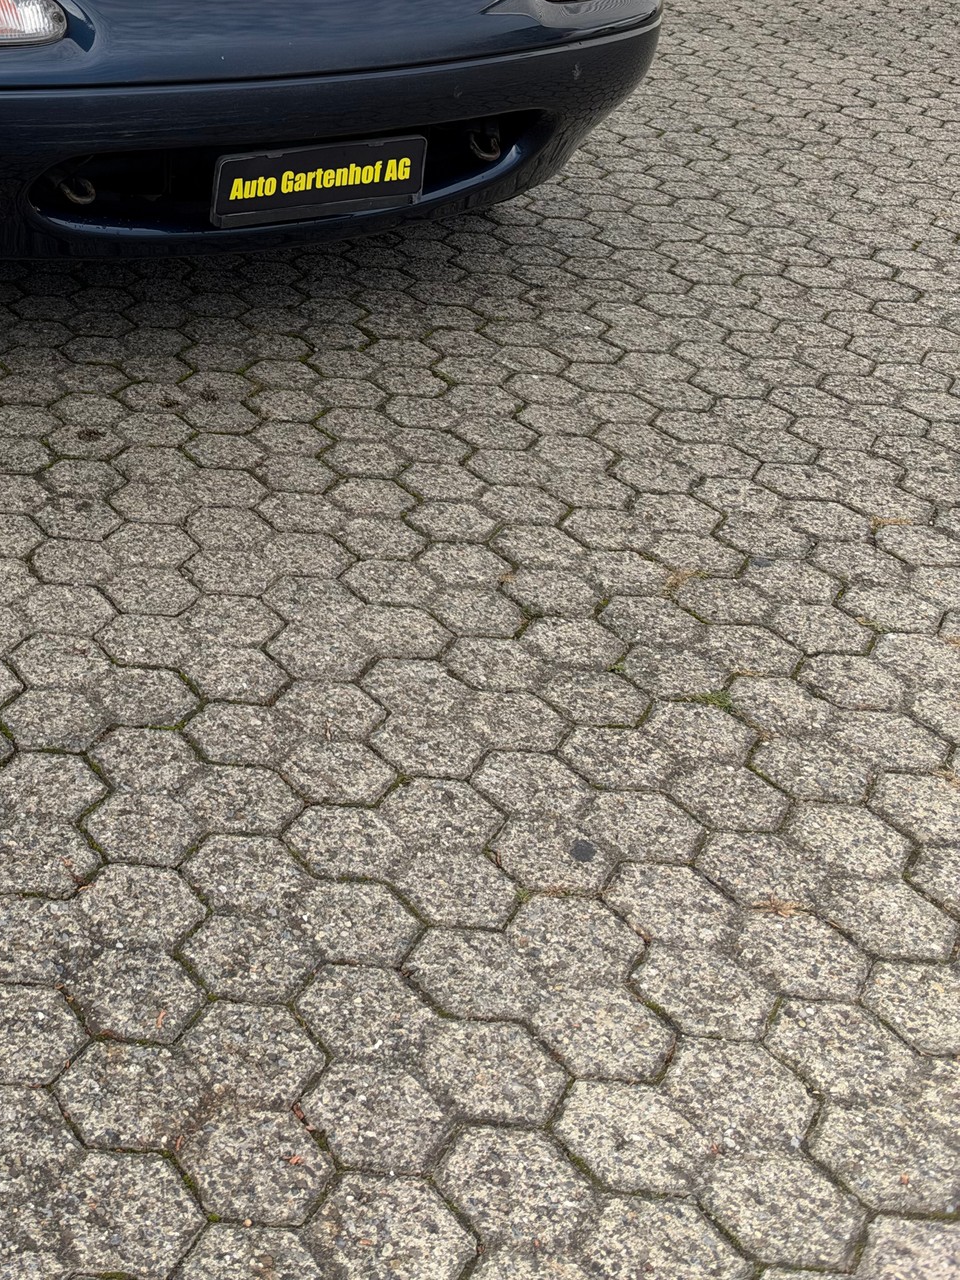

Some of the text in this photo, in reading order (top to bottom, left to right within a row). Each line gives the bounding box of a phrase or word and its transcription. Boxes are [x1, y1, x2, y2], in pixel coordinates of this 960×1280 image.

[229, 157, 411, 200] Auto Gartenhof AG
